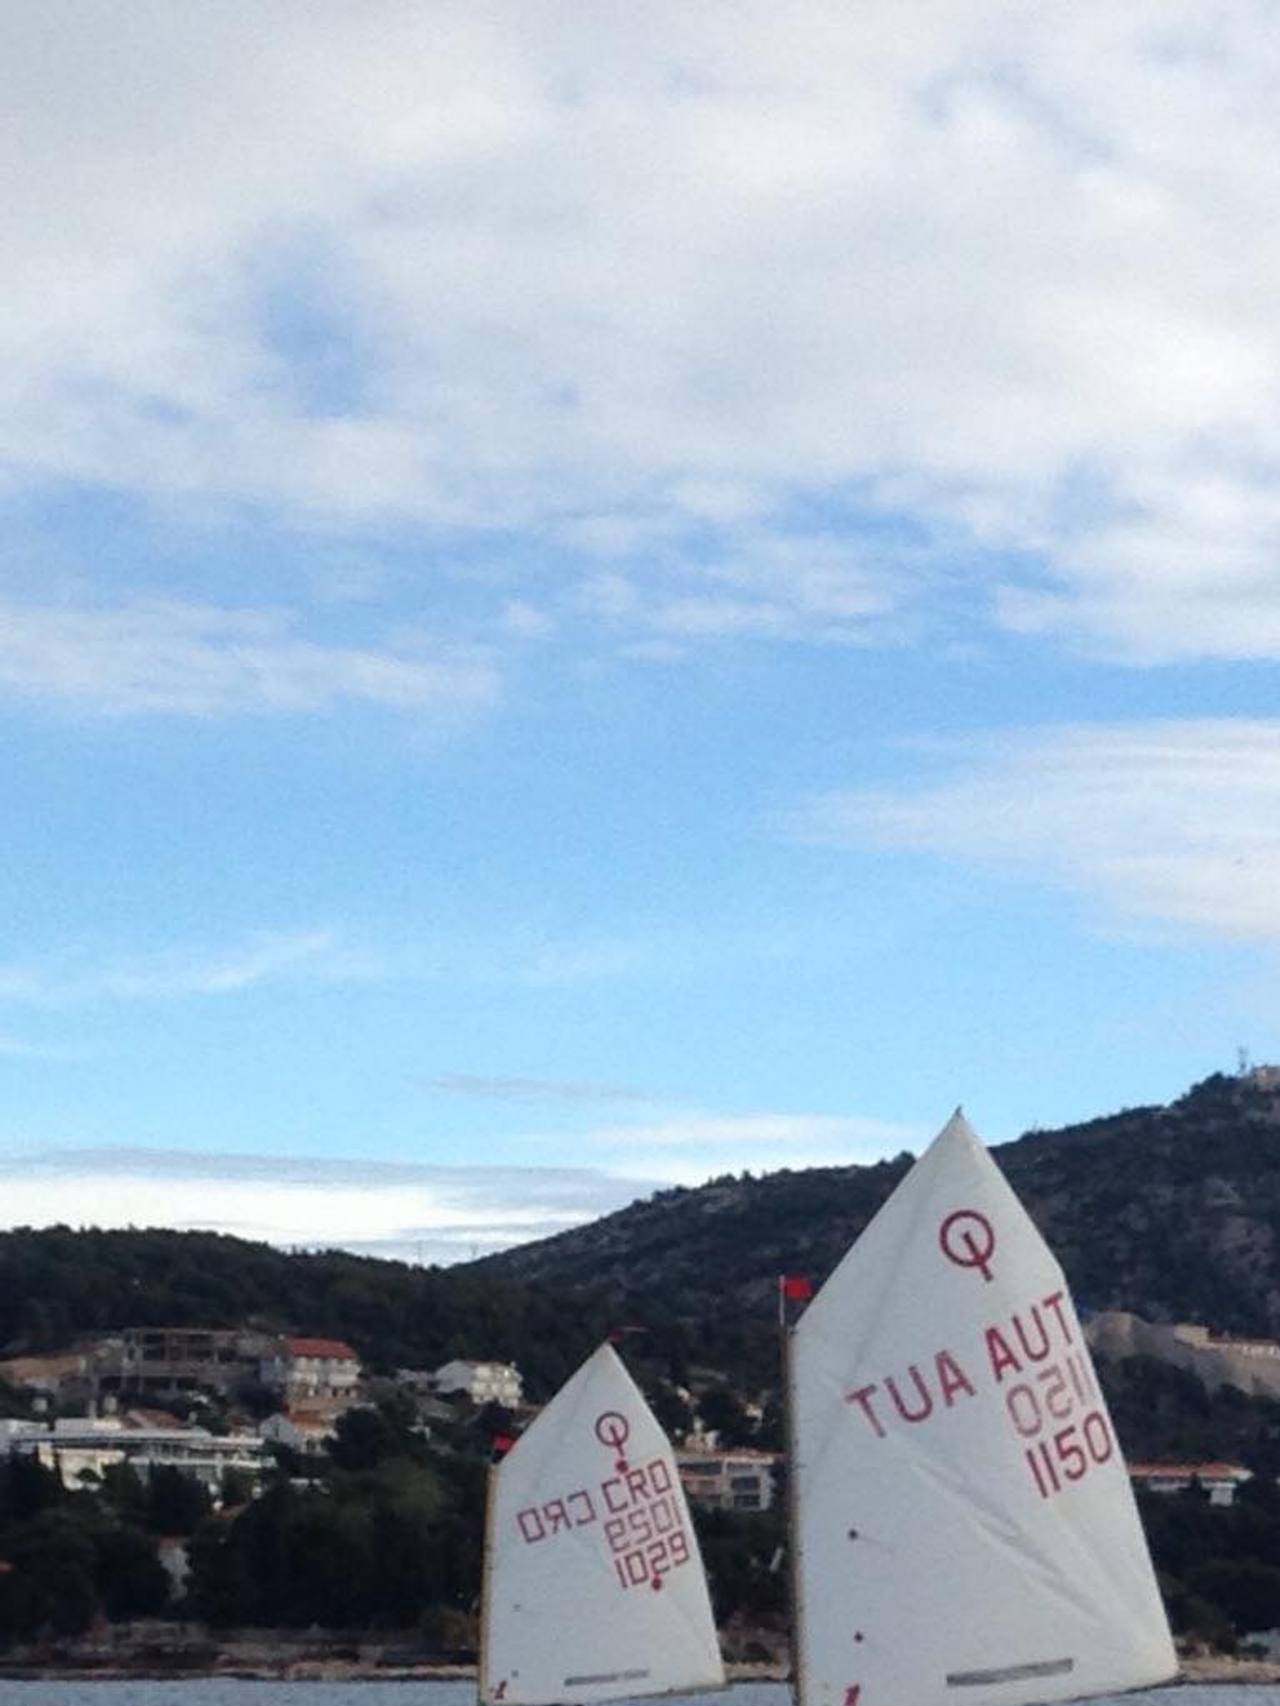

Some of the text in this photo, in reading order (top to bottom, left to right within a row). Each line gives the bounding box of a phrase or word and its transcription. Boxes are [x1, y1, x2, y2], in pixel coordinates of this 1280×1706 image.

[984, 1292, 1075, 1382] AUT
[601, 1459, 674, 1516] CRO
[1025, 1411, 1113, 1498] 1150
[614, 1530, 691, 1589] 1029
